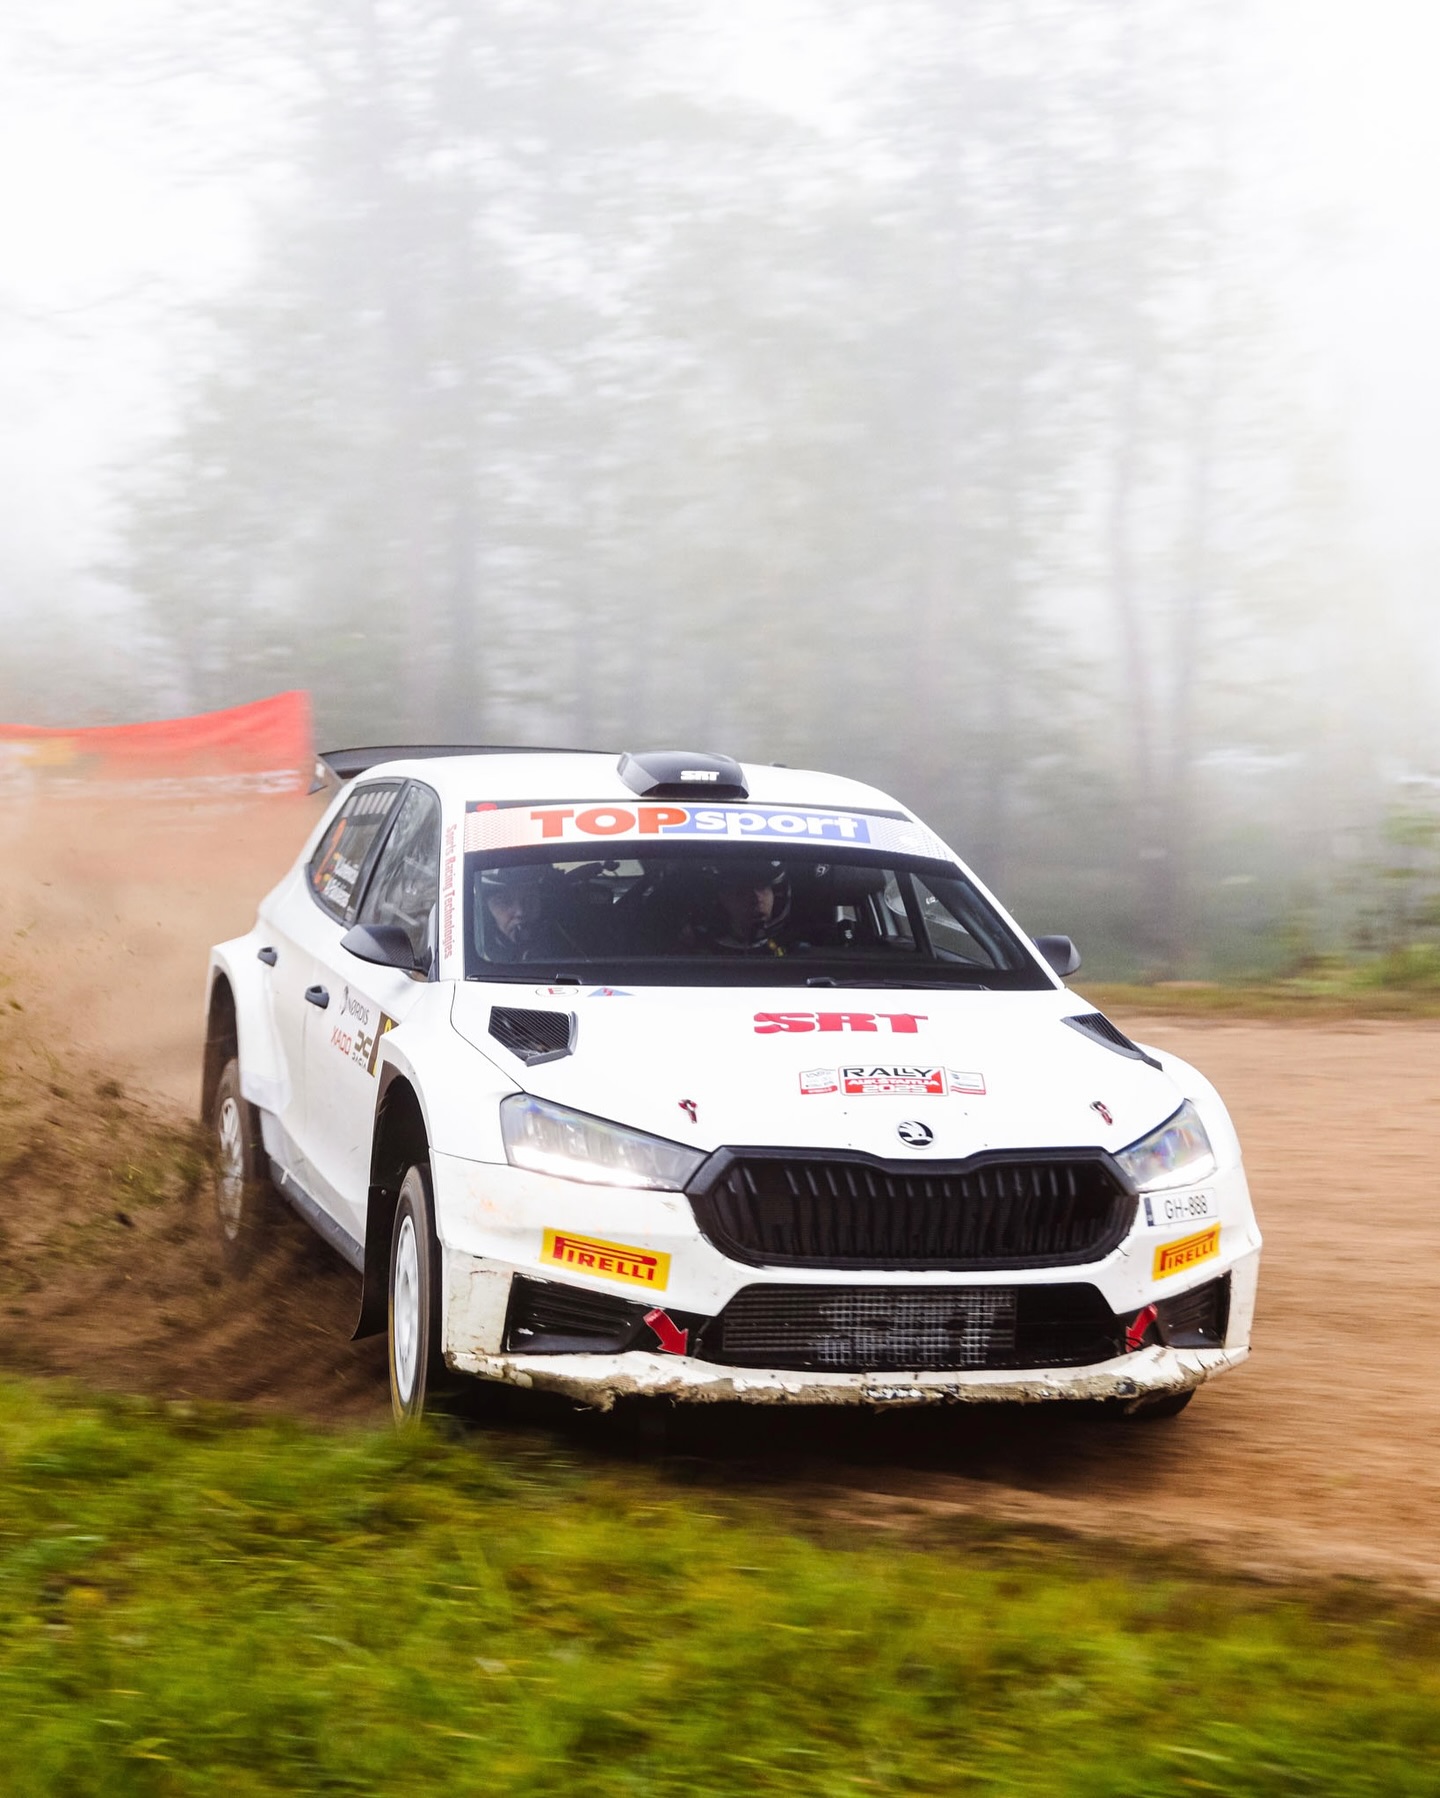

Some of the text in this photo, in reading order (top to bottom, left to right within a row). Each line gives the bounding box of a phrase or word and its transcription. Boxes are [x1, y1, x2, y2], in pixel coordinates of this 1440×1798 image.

[680, 770, 720, 781] SRT
[443, 824, 457, 960] Sports Racing Technologies
[753, 1012, 929, 1034] SRT
[843, 1067, 933, 1078] RALLY
[863, 1085, 927, 1094] 2025
[1164, 1195, 1208, 1219] GH-888
[552, 1236, 658, 1281] PIRELLI
[1159, 1230, 1216, 1272] PIRELLI
